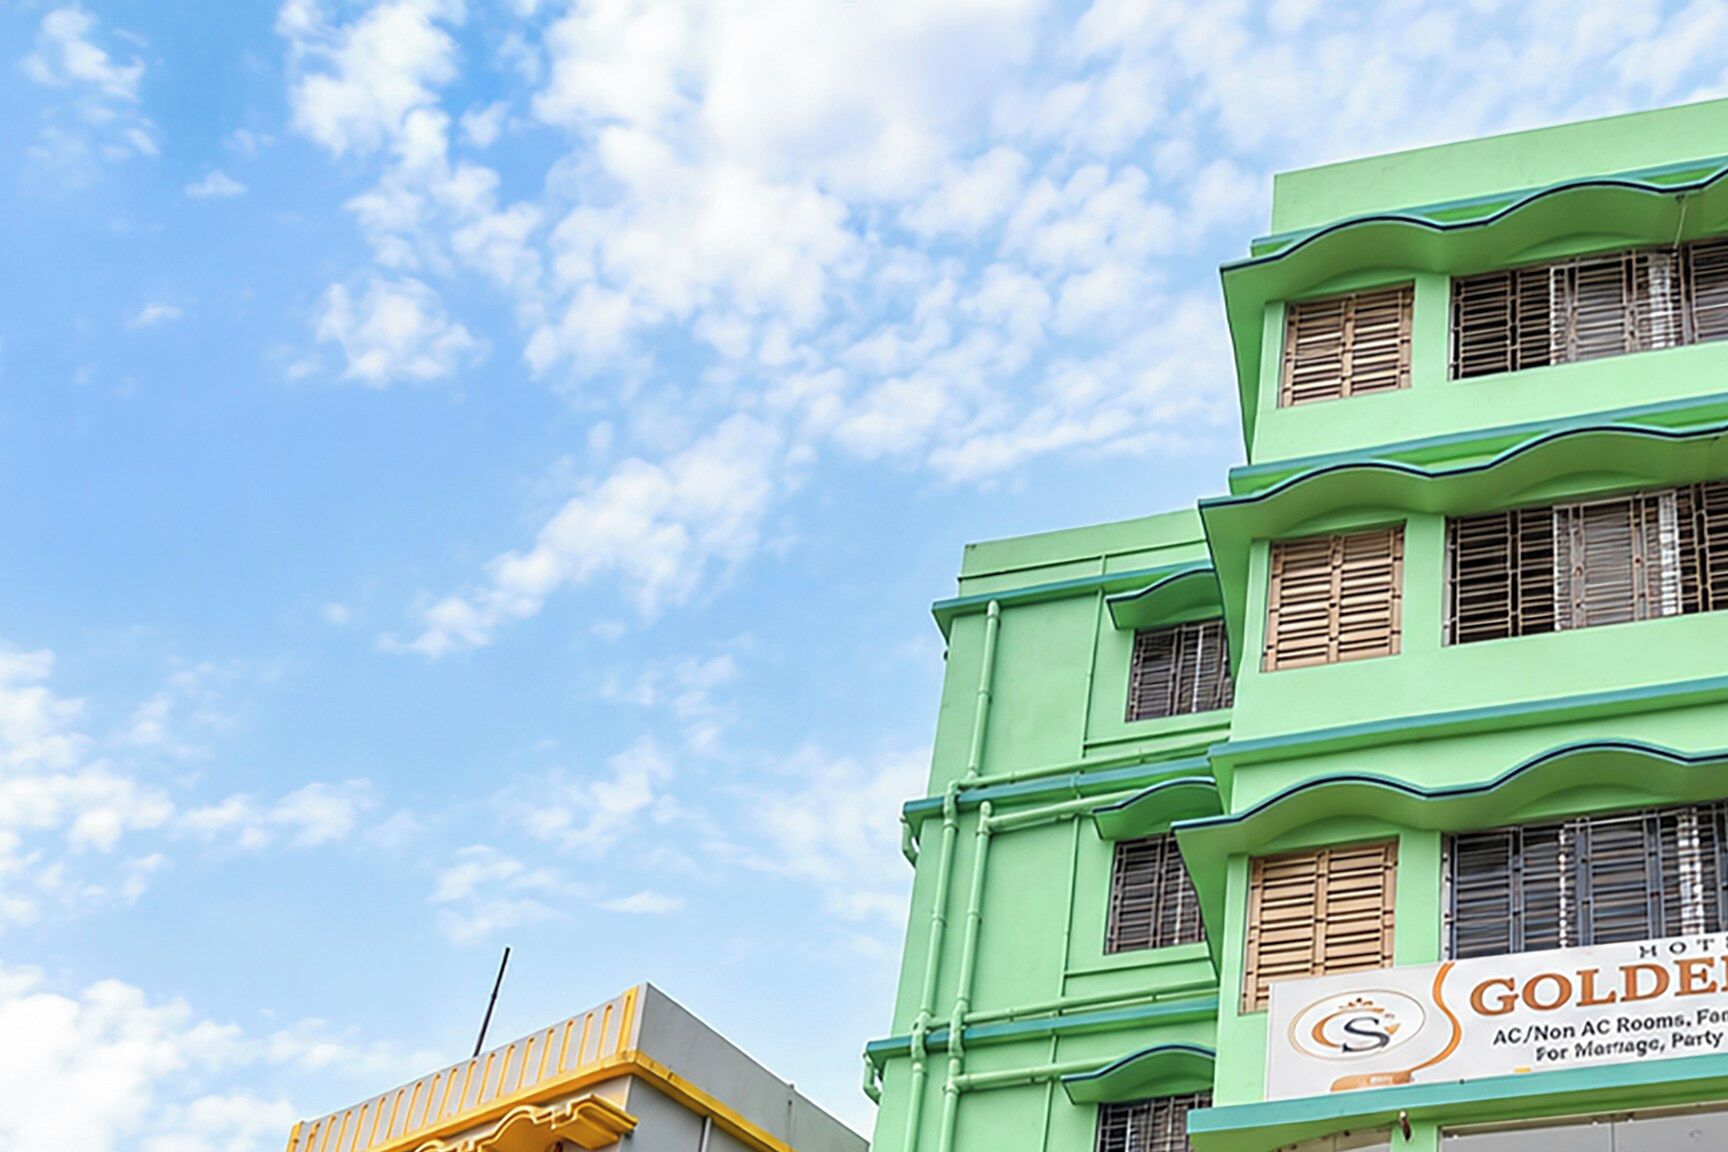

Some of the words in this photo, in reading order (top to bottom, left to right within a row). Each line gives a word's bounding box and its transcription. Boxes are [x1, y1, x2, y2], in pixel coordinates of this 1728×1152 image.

[1493, 1024, 1576, 1046] AC/Non
[1581, 1019, 1610, 1037] AC
[1536, 1046, 1569, 1062] For
[1671, 1028, 1725, 1049] Party
